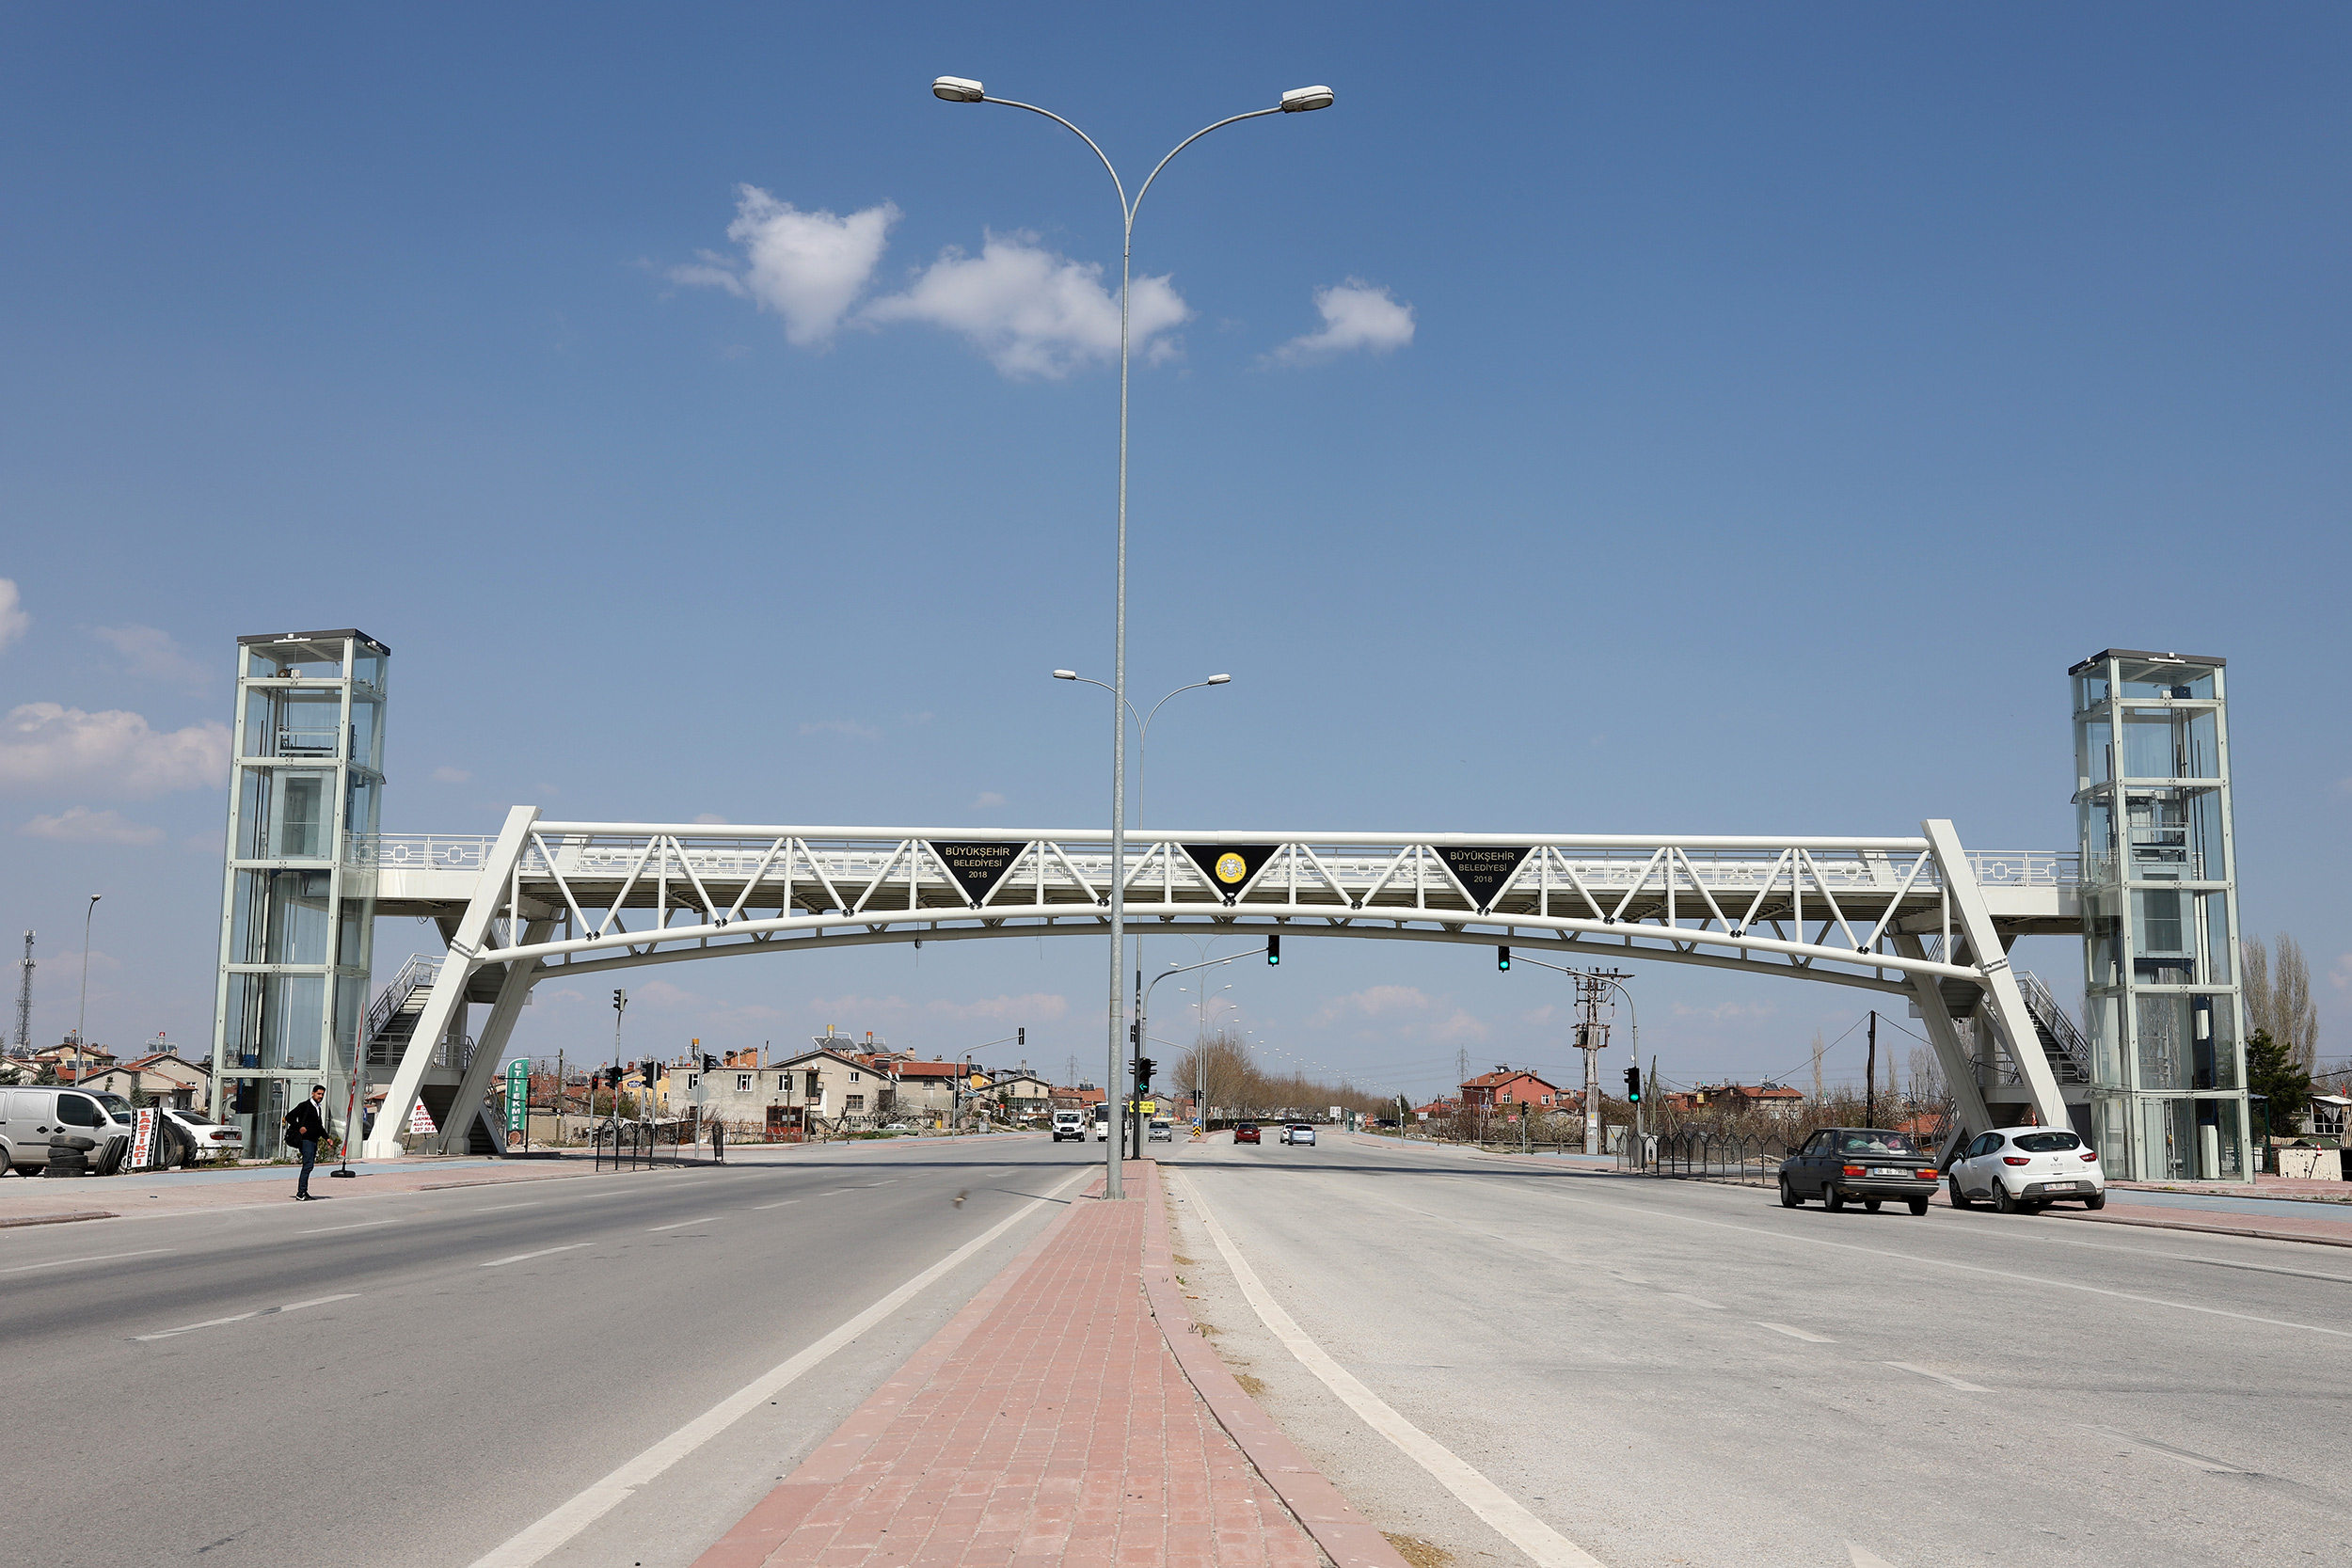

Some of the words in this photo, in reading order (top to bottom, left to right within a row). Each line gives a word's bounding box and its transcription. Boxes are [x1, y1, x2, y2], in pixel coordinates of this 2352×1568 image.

[946, 846, 1010, 857] BÜYÜKŞEHİR
[1450, 850, 1515, 863] BÜYÜKŞEHİR
[953, 858, 1002, 867] BELEDİYESİ
[1458, 863, 1507, 872] BELEDİYESİ
[968, 870, 988, 879] 2018
[1473, 875, 1493, 883] 2018
